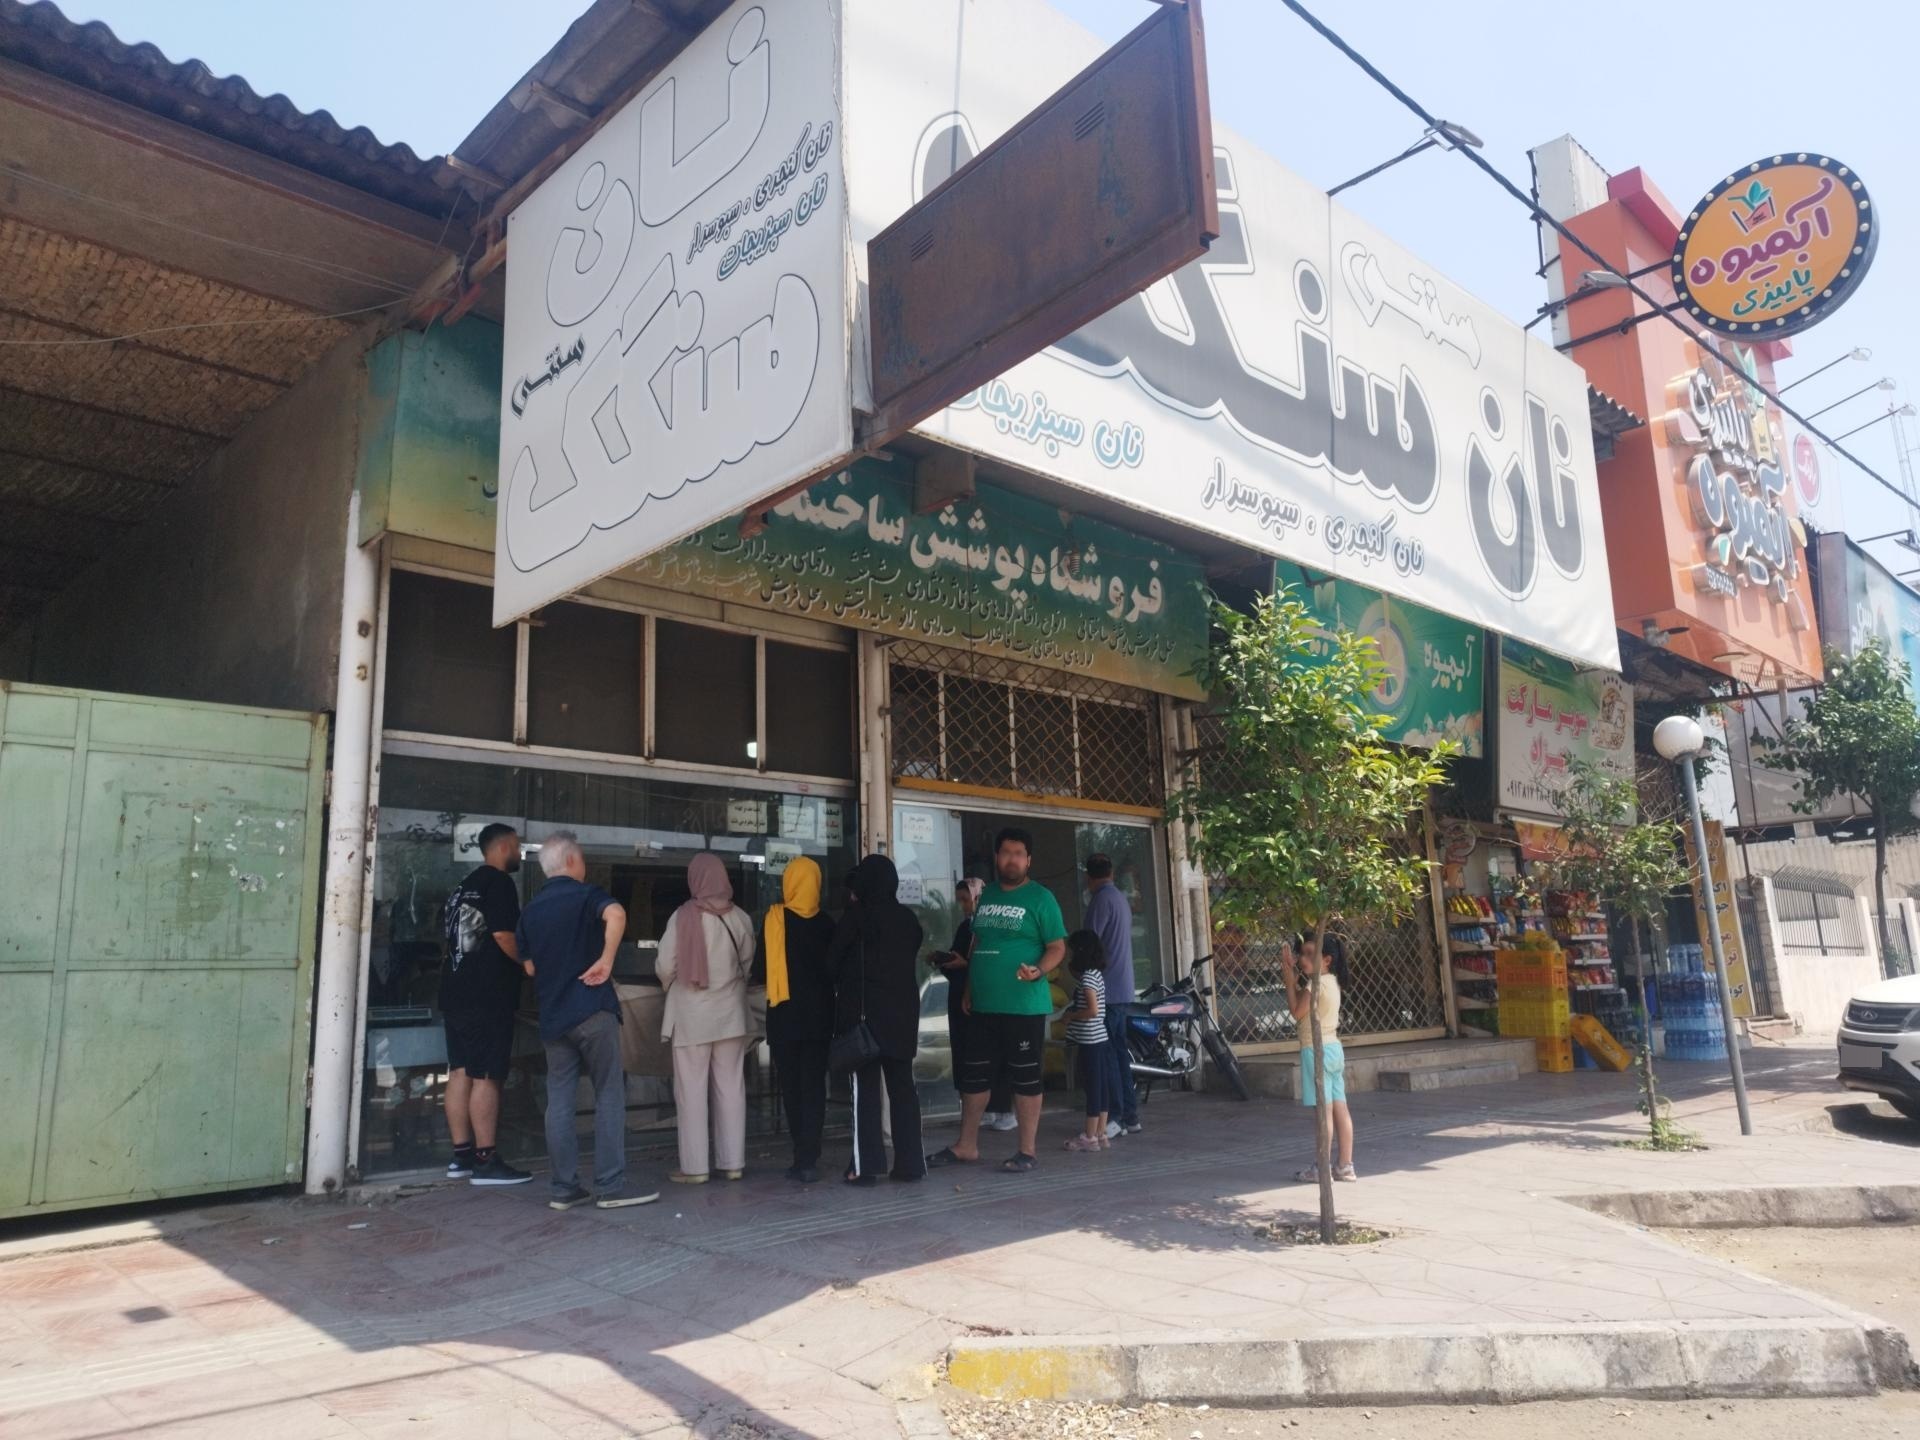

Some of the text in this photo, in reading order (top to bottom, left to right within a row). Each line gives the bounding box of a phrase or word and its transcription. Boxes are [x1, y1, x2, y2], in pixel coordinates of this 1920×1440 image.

[547, 6, 770, 327] نان
[753, 122, 812, 212] کنجدی
[803, 121, 833, 173] نان
[717, 173, 828, 281] نان سبزیجات
[1690, 177, 1833, 284] آبمیوه
[510, 333, 586, 419] سنتی
[1092, 419, 1144, 469] نان
[1465, 385, 1586, 600] نان
[1324, 511, 1396, 566] کنجدی
[1392, 536, 1424, 577] نان
